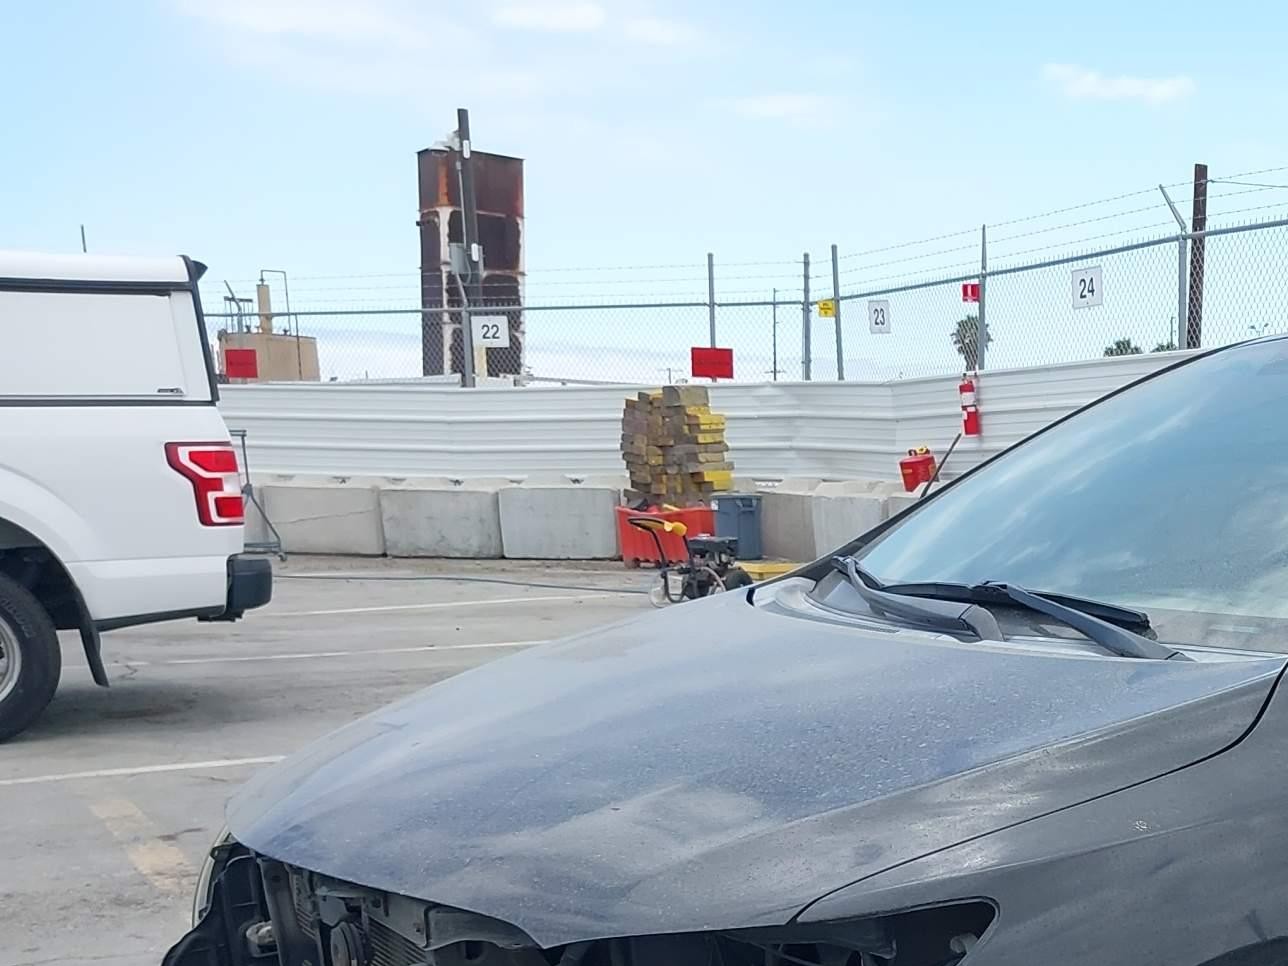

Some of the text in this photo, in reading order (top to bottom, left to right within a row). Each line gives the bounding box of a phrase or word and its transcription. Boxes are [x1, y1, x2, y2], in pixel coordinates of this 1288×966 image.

[1079, 276, 1096, 299] 24
[873, 308, 886, 326] 23
[481, 324, 501, 340] 22
